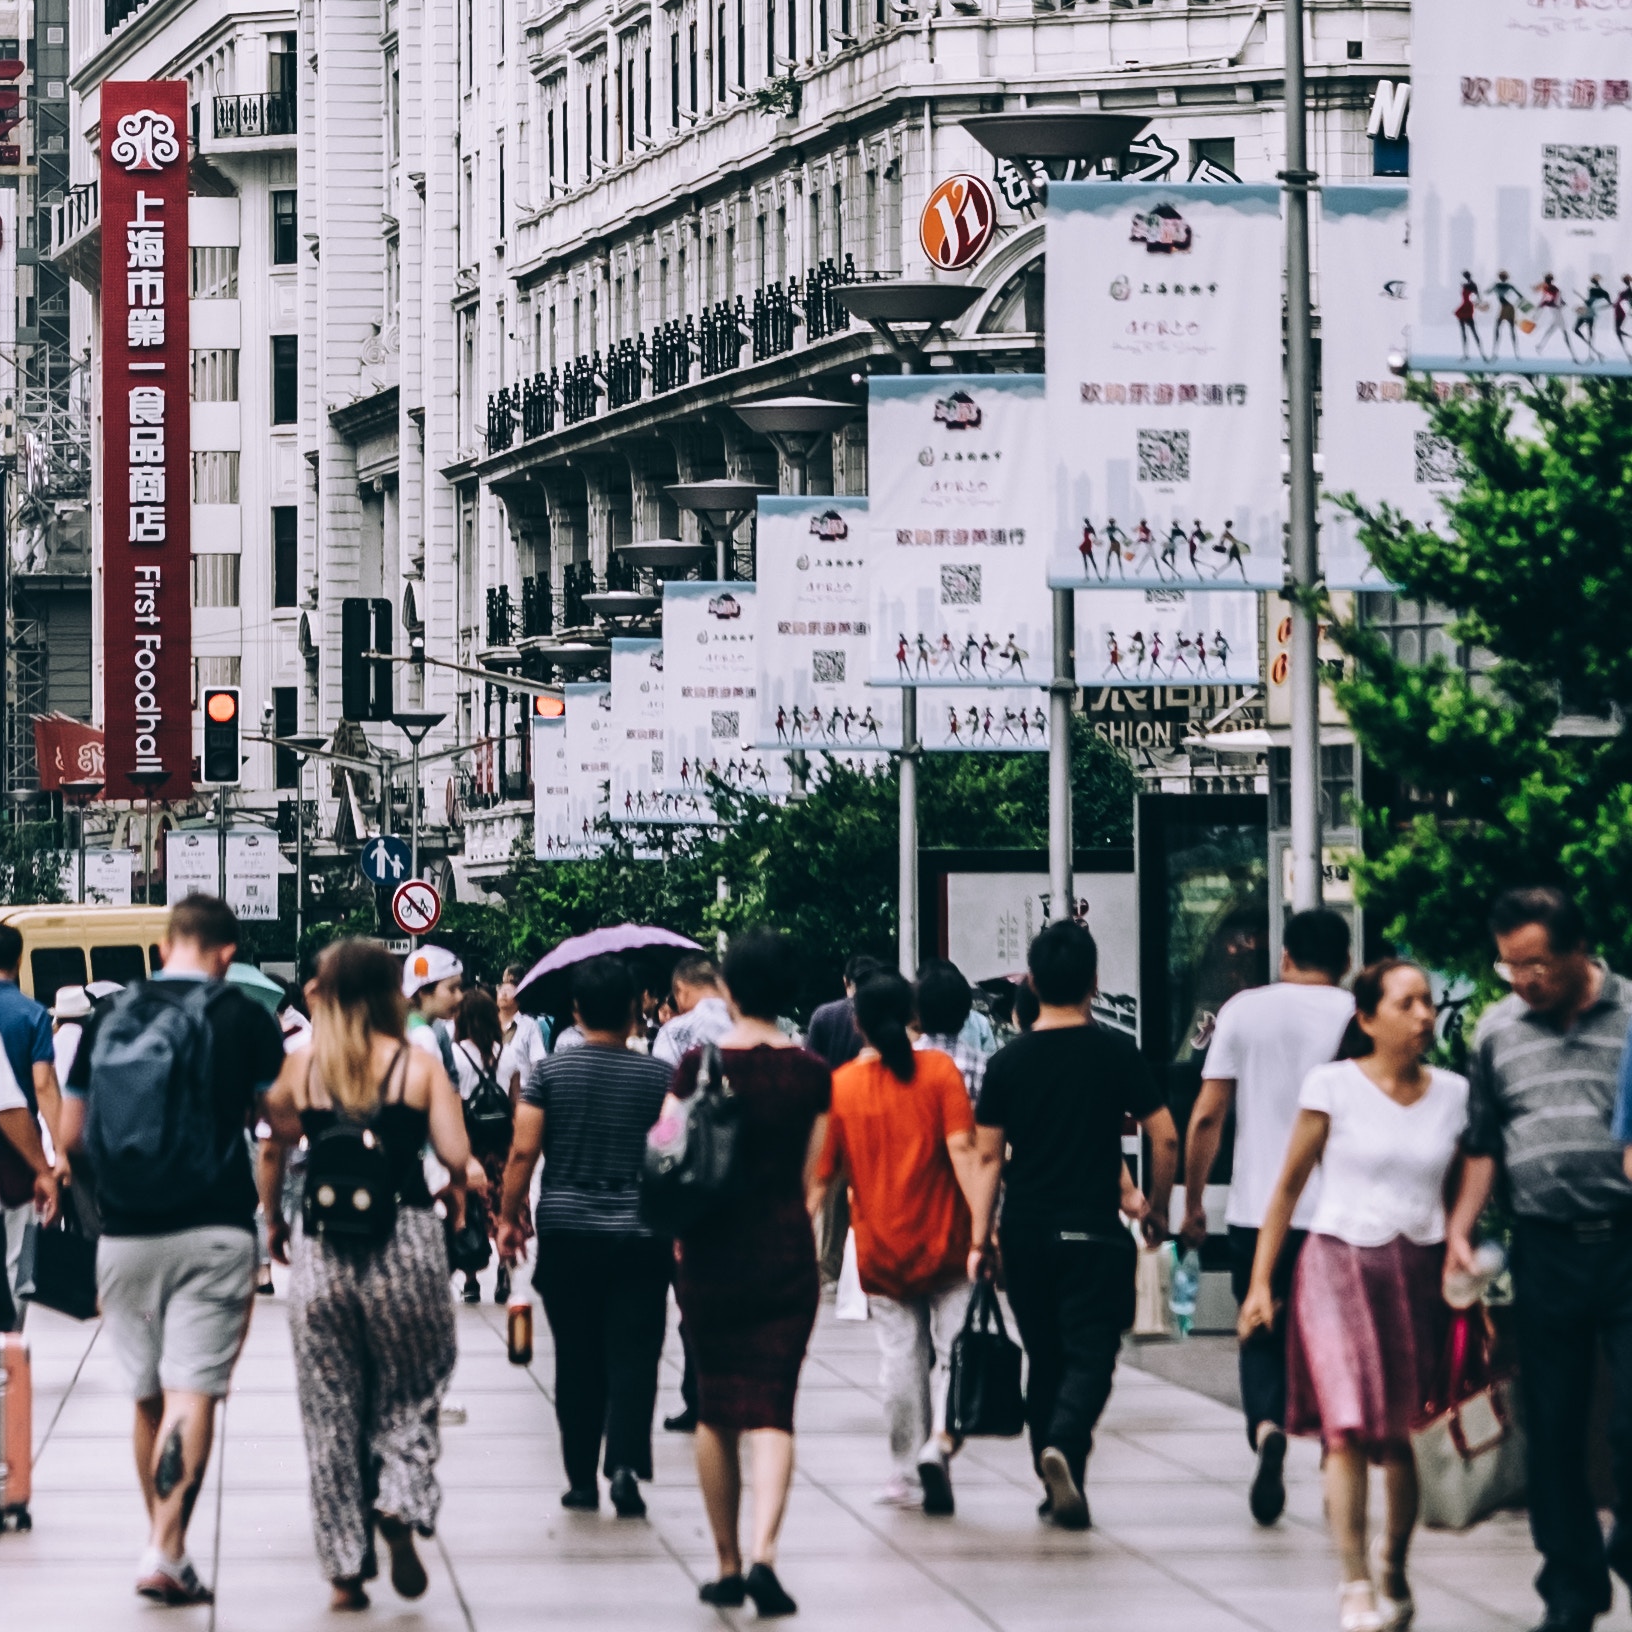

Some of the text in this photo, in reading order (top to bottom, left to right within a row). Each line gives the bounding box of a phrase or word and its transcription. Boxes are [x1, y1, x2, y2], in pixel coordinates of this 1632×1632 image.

[126, 190, 166, 543] 上海市第一食品商店
[134, 565, 162, 773] First Foodhall
